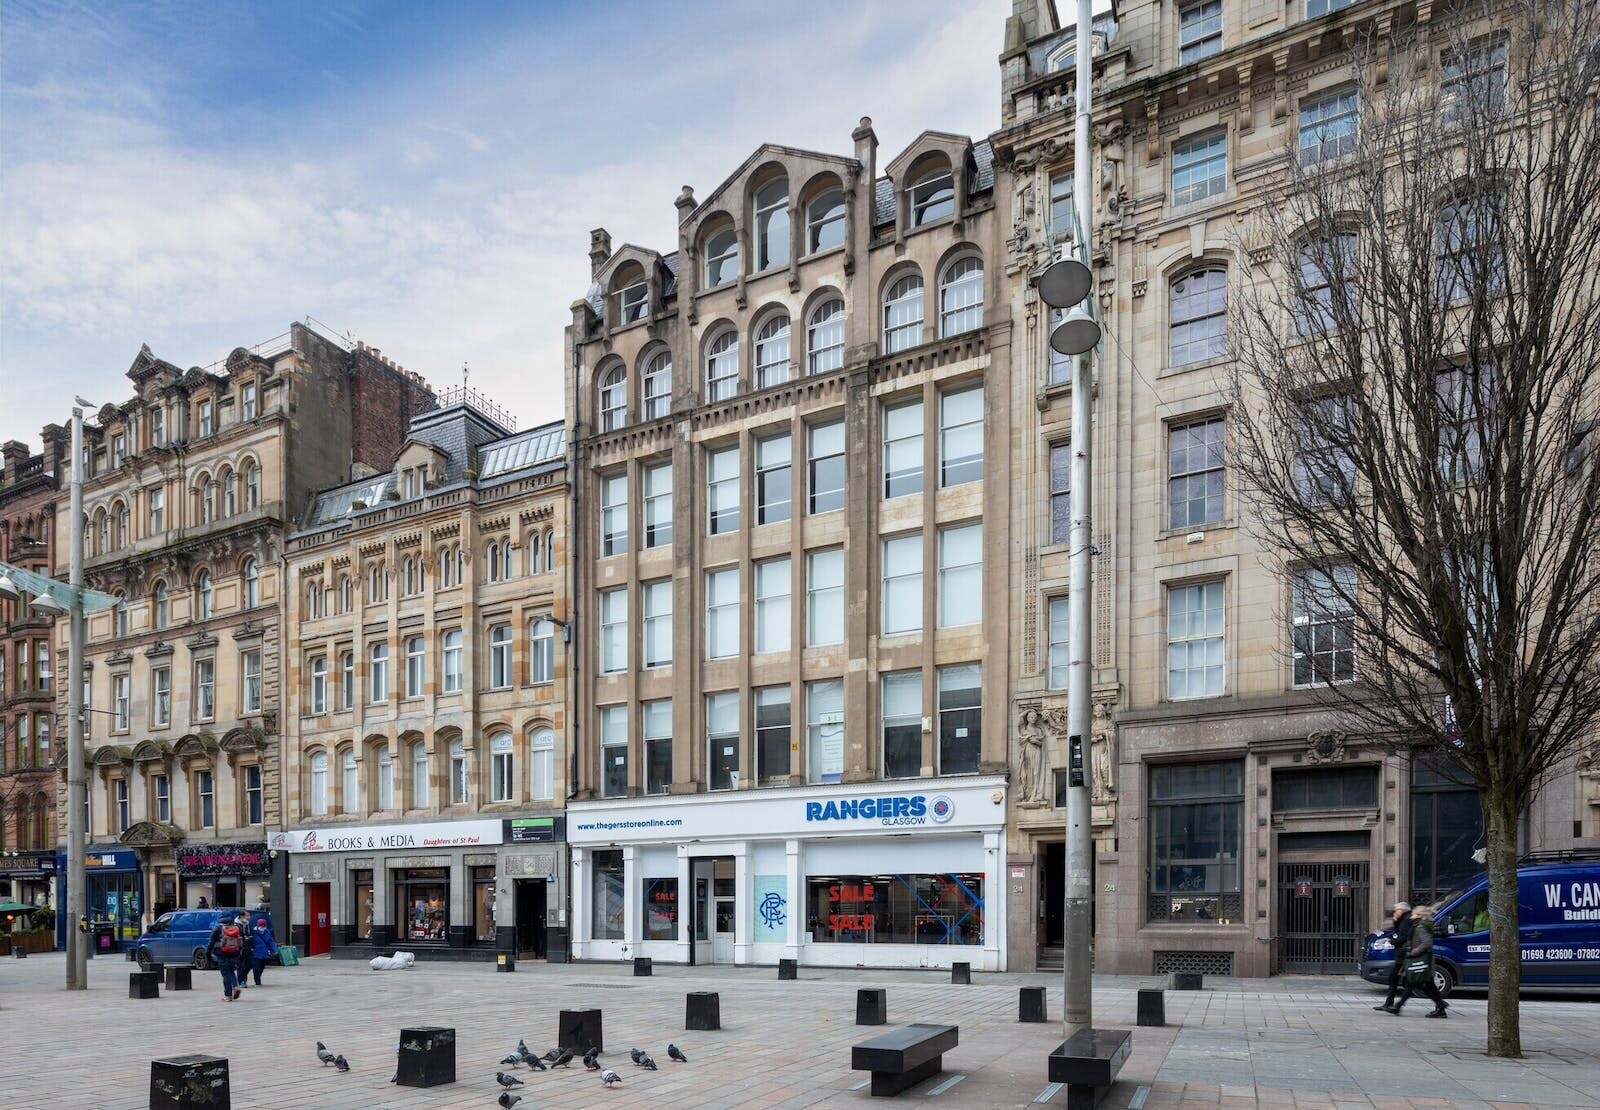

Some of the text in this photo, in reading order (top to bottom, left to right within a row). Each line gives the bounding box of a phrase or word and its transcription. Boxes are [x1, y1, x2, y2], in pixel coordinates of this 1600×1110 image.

[806, 795, 927, 822] RANGERS
[577, 818, 683, 830] www.thegersstoreonline.com
[881, 816, 926, 826] GLASGOW
[328, 835, 415, 850] BOOKS & MEDIA
[423, 838, 451, 847] Daughters
[467, 836, 480, 844] Paul
[102, 854, 117, 866] HILL
[828, 885, 875, 902] SALE
[1013, 885, 1024, 894] 24
[1104, 883, 1116, 892] 24
[655, 892, 676, 901] SALE
[1544, 883, 1567, 908] W.
[828, 913, 875, 931] SALE
[1521, 949, 1544, 960] 01698
